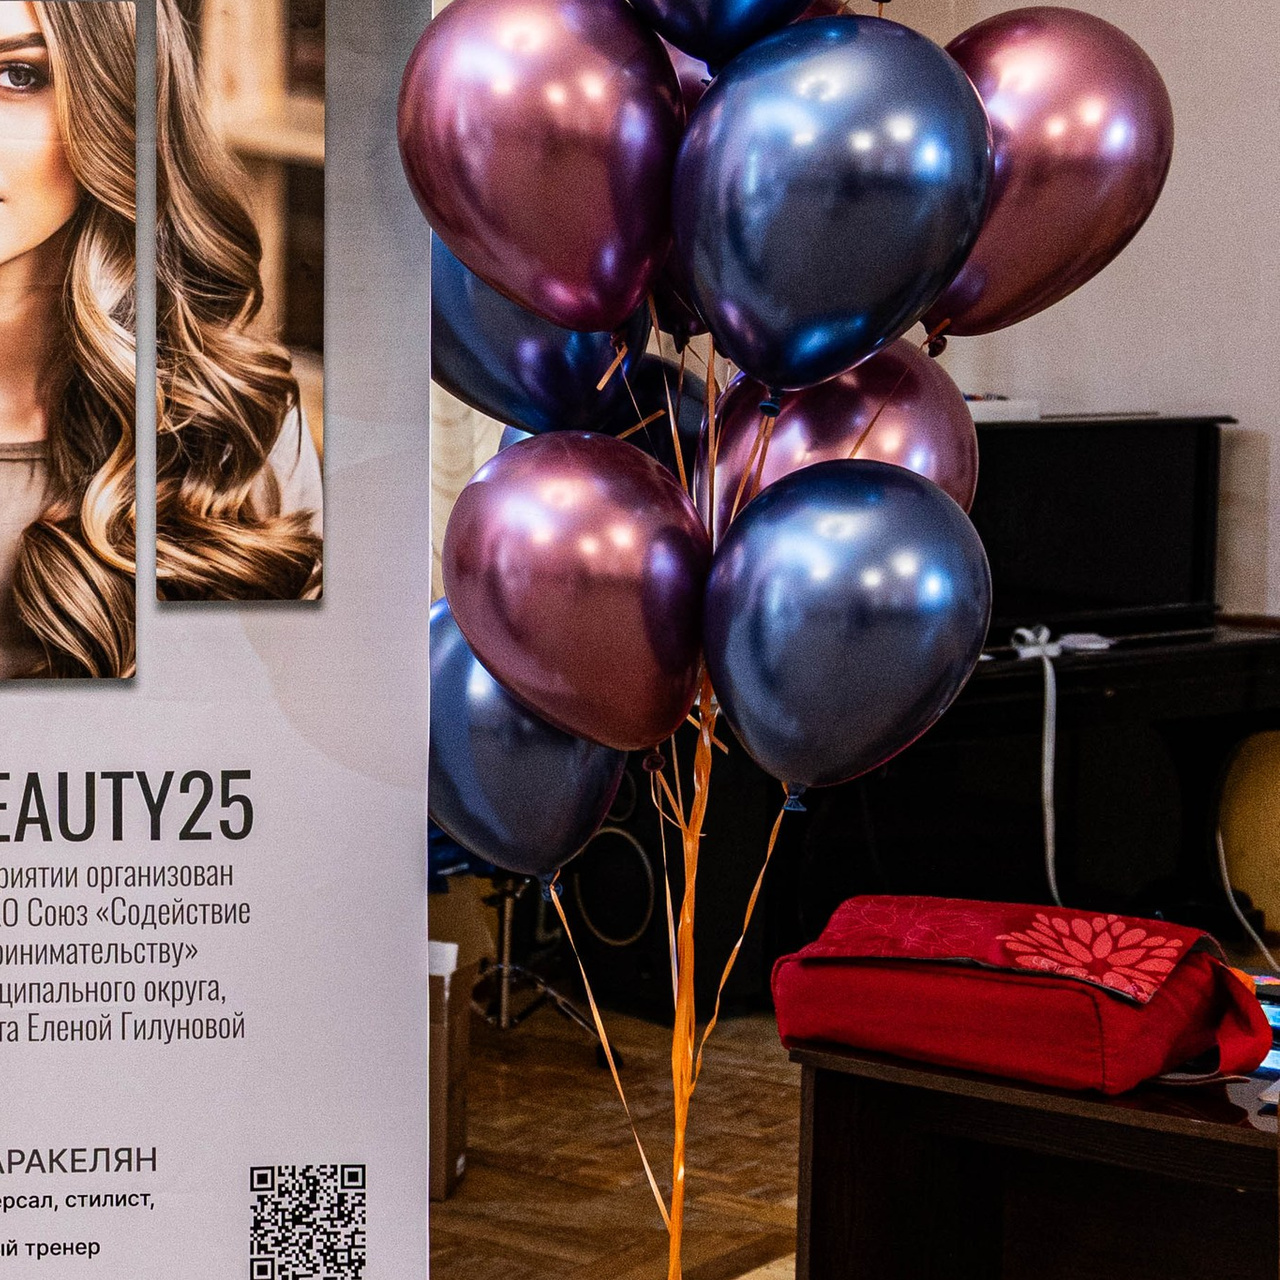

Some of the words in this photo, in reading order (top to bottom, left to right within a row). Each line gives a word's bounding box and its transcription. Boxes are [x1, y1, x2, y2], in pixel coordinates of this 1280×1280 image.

[86, 864, 233, 894] организован
[27, 897, 88, 927] Союз
[96, 896, 251, 930] «Содействие
[144, 979, 226, 1009] округа,
[28, 1012, 112, 1042] Еленой
[121, 1011, 245, 1045] Гилуновой
[64, 1192, 155, 1211] стилист,
[24, 1241, 101, 1261] тренер
